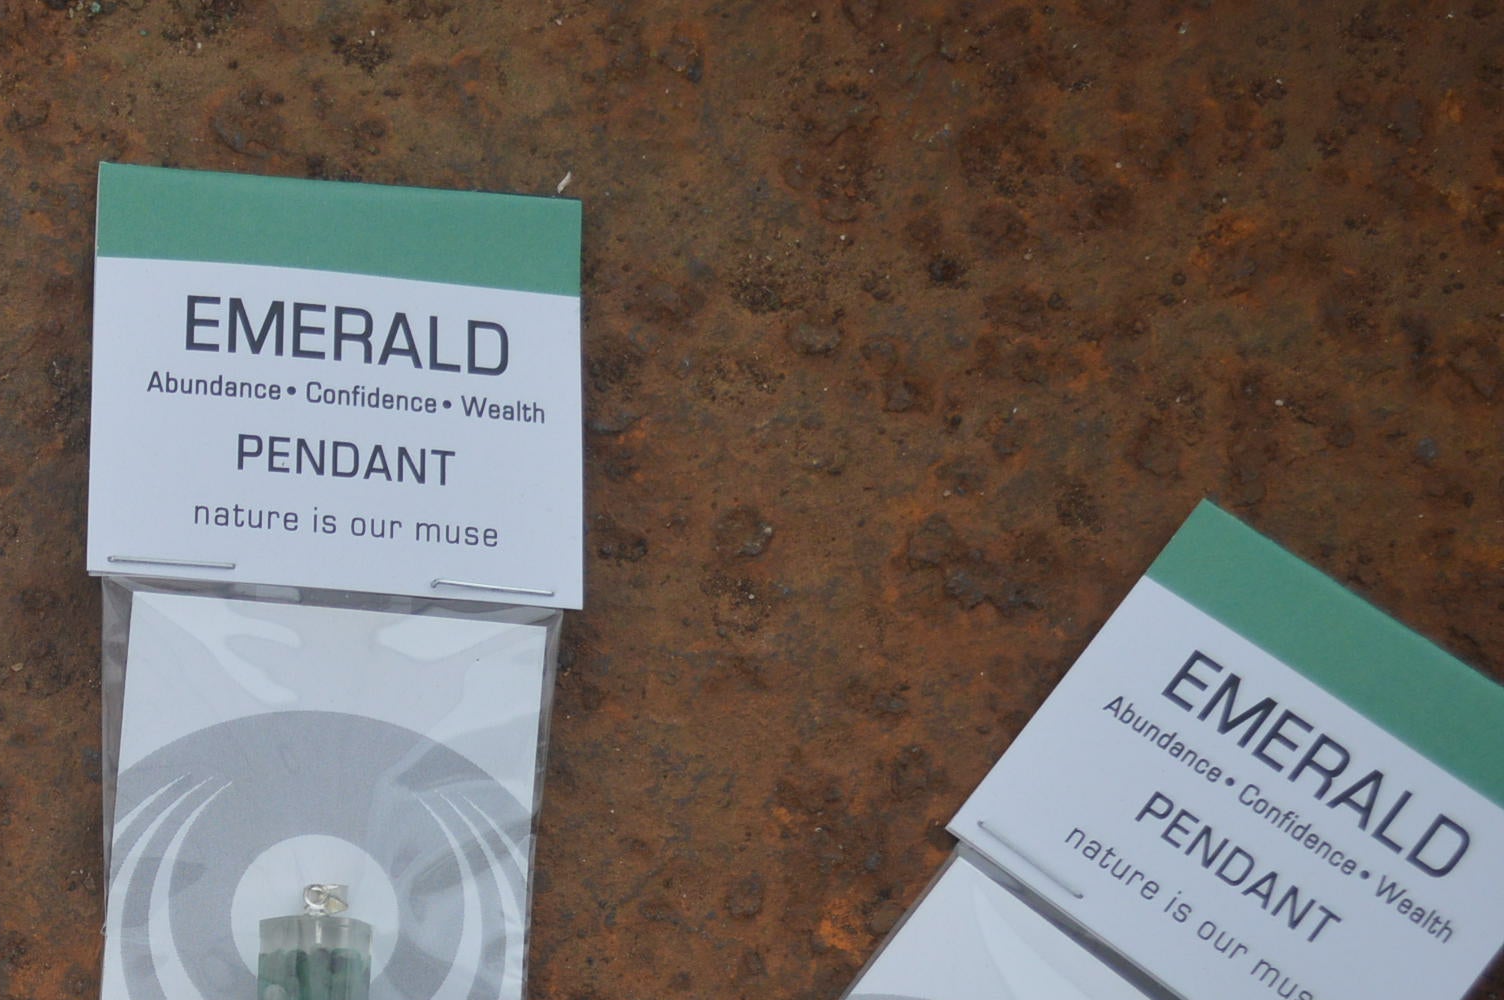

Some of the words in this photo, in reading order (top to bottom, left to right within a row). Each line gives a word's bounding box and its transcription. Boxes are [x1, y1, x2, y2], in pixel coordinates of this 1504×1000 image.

[185, 295, 509, 376] EMERALD
[461, 395, 545, 424] Wealth
[237, 433, 456, 486] PENDANT
[194, 504, 298, 531] nature
[312, 506, 337, 535] is
[351, 517, 402, 539] our
[416, 522, 497, 547] muse
[1161, 649, 1471, 878] EMERALD
[1065, 828, 1160, 900] nature
[1163, 891, 1194, 925] is
[1197, 921, 1248, 959] our
[1134, 791, 1342, 943] PENDANT
[1376, 875, 1453, 943] Wealth
